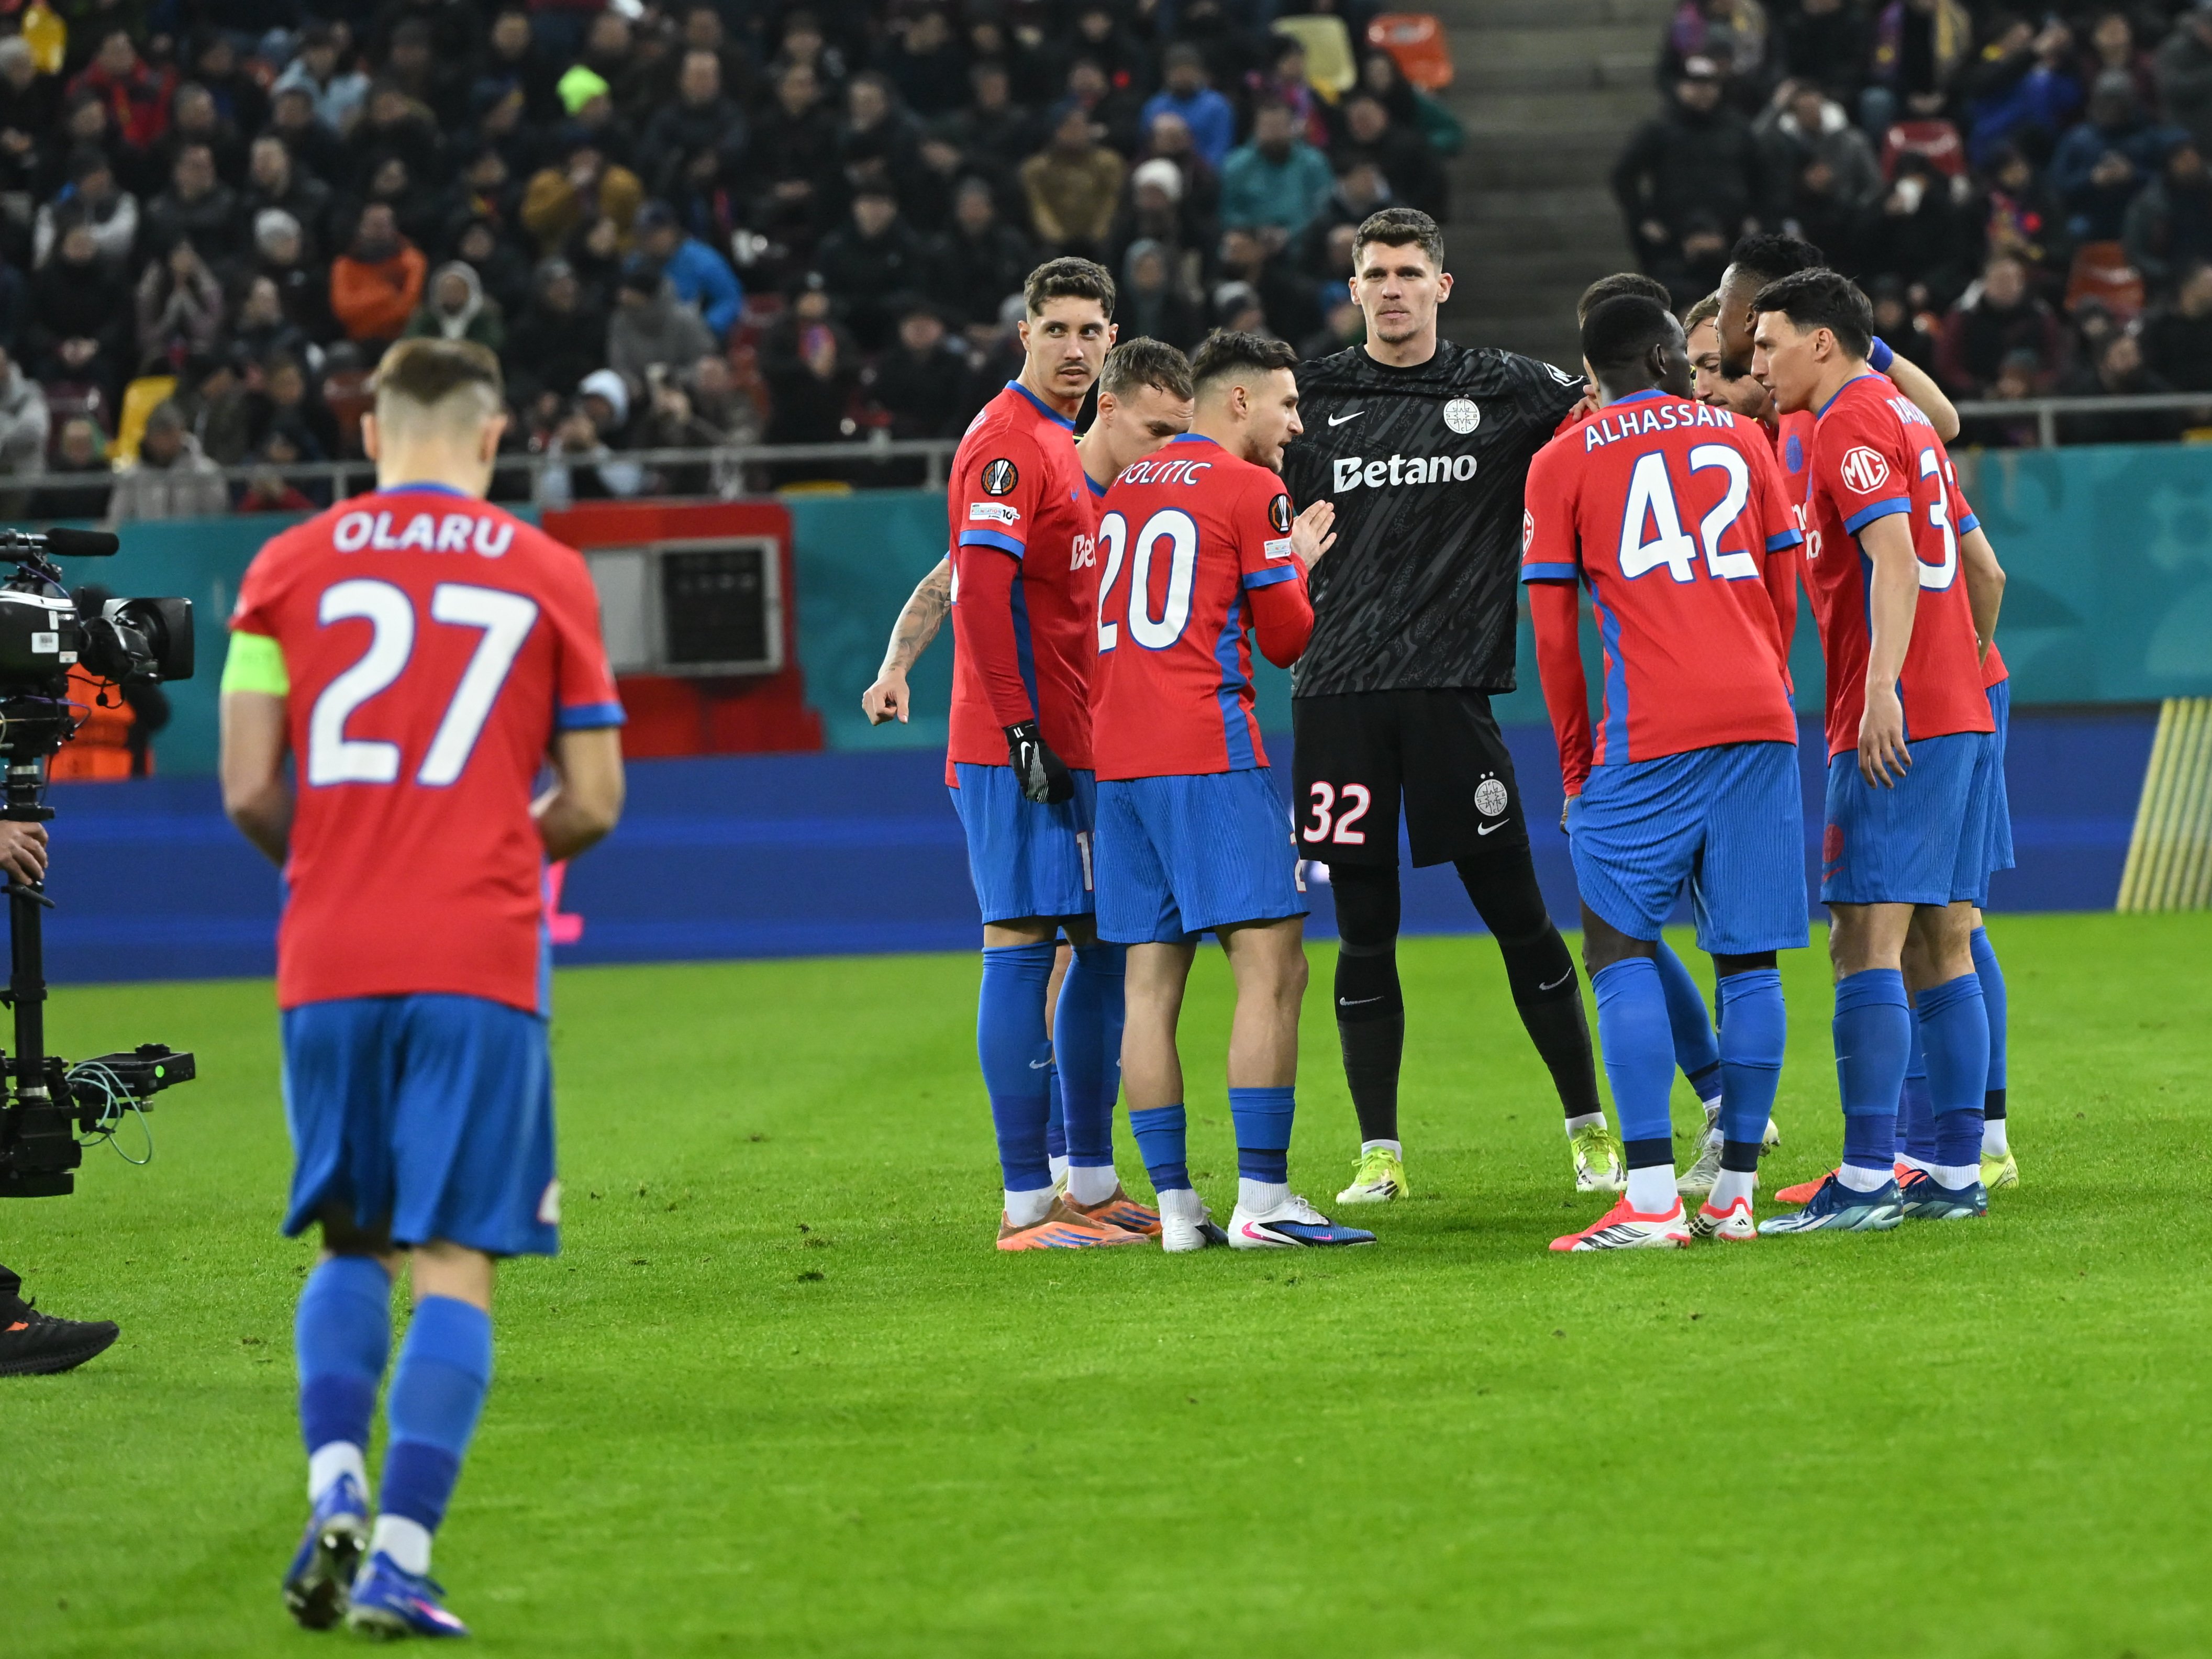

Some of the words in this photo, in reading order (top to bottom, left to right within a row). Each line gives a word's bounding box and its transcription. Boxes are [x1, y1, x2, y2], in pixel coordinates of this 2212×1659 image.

[1585, 403, 1735, 453] ALHASSAN
[1333, 454, 1478, 494] Betano
[1843, 449, 1885, 491] MG
[332, 510, 515, 559] OLARU
[1618, 443, 1759, 584] 42
[1098, 507, 1199, 656] 20
[308, 576, 539, 787] 27
[1303, 781, 1371, 845] 32
